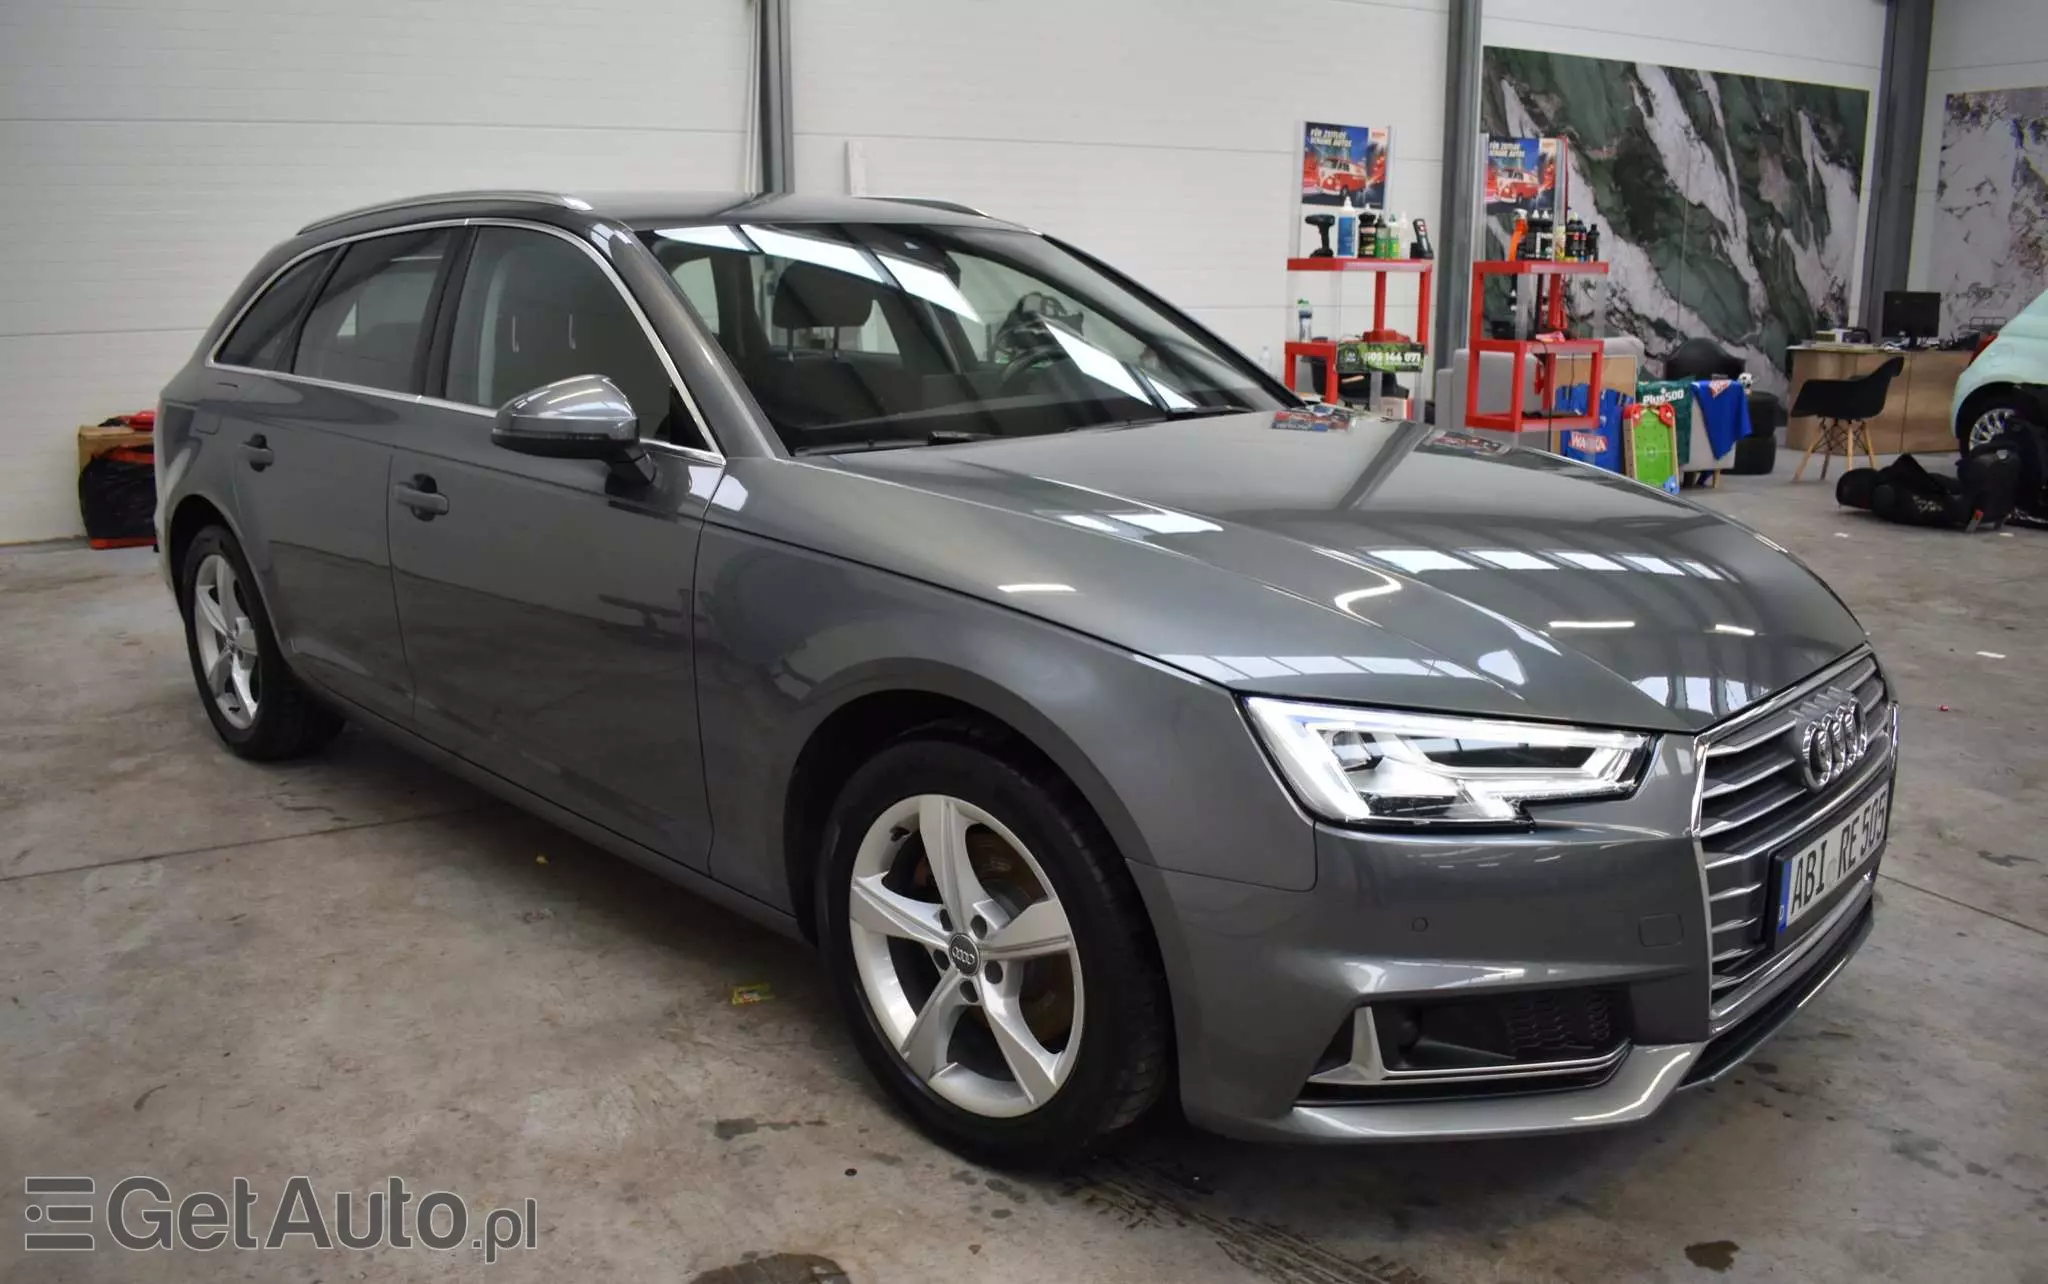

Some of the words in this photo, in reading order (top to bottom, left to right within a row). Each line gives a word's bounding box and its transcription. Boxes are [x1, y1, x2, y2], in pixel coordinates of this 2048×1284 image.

[1790, 839, 1827, 916] ABI
[1837, 815, 1860, 881] RE
[1860, 790, 1885, 857] 505
